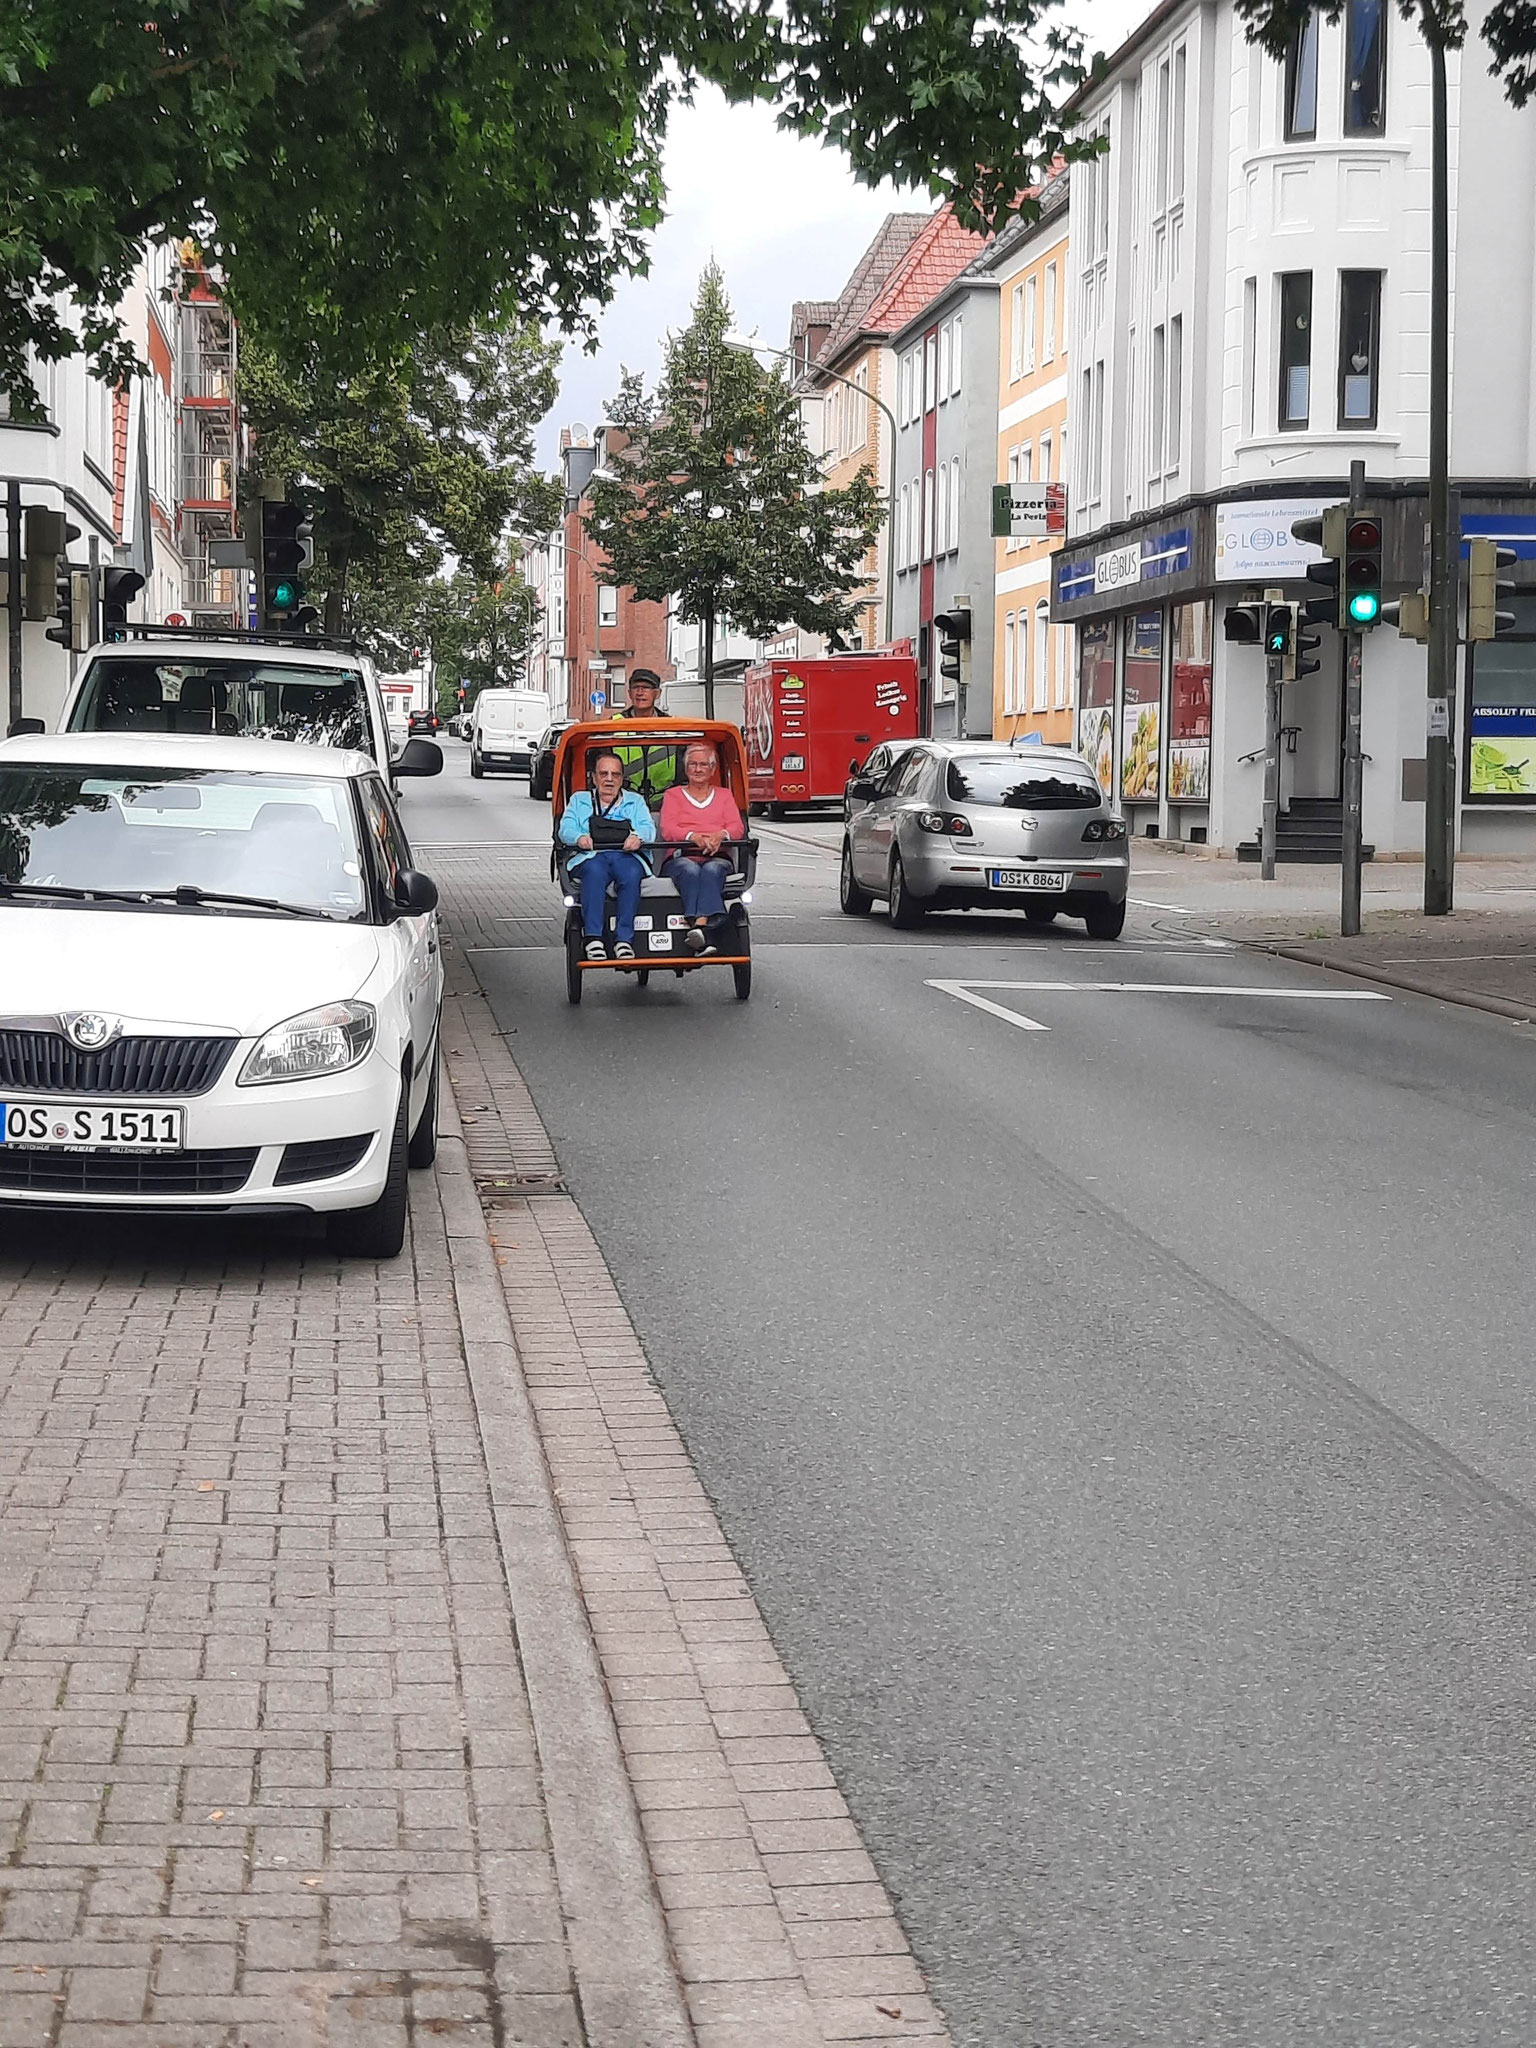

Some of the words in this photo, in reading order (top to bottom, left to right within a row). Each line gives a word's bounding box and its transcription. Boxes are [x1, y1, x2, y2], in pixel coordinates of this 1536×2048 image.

[1000, 498, 1057, 510] Pizzeria
[1098, 551, 1137, 584] GLOBUS
[1473, 707, 1518, 717] ABSOLUT
[1001, 872, 1015, 884] OS
[1023, 874, 1031, 885] K
[1033, 874, 1061, 886] 8864
[8, 1108, 48, 1138] OS
[74, 1111, 92, 1140] S
[101, 1112, 178, 1143] 1511
